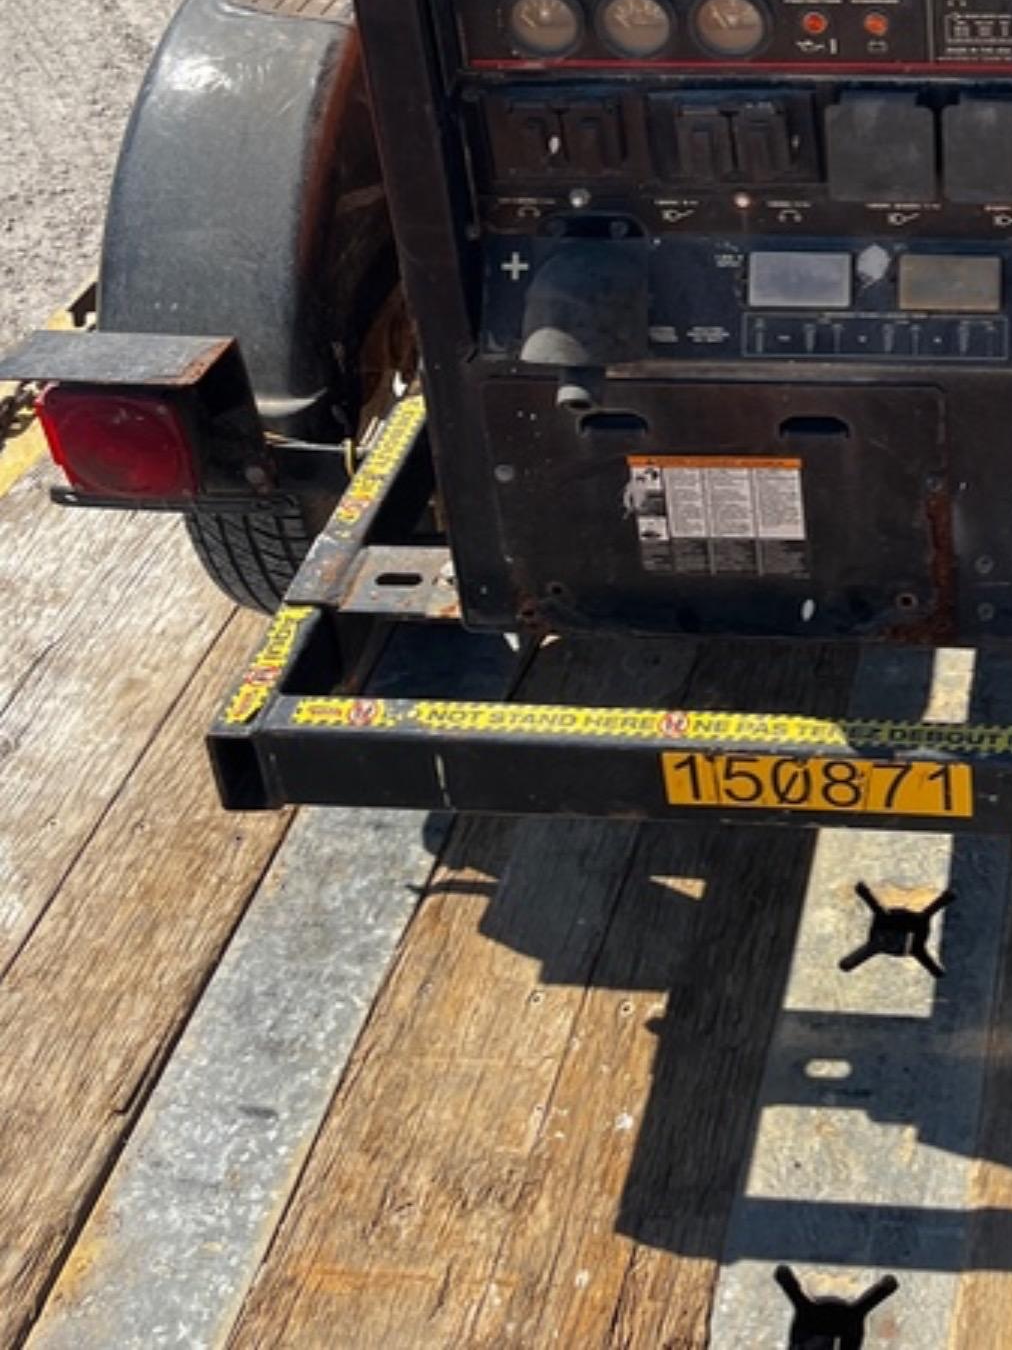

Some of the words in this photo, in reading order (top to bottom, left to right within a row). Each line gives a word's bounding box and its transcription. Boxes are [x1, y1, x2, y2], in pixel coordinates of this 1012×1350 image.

[427, 708, 484, 724] NOT
[489, 711, 577, 727] STAND
[583, 714, 657, 731] HERE
[692, 718, 728, 734] NE
[671, 753, 954, 811] 150871
